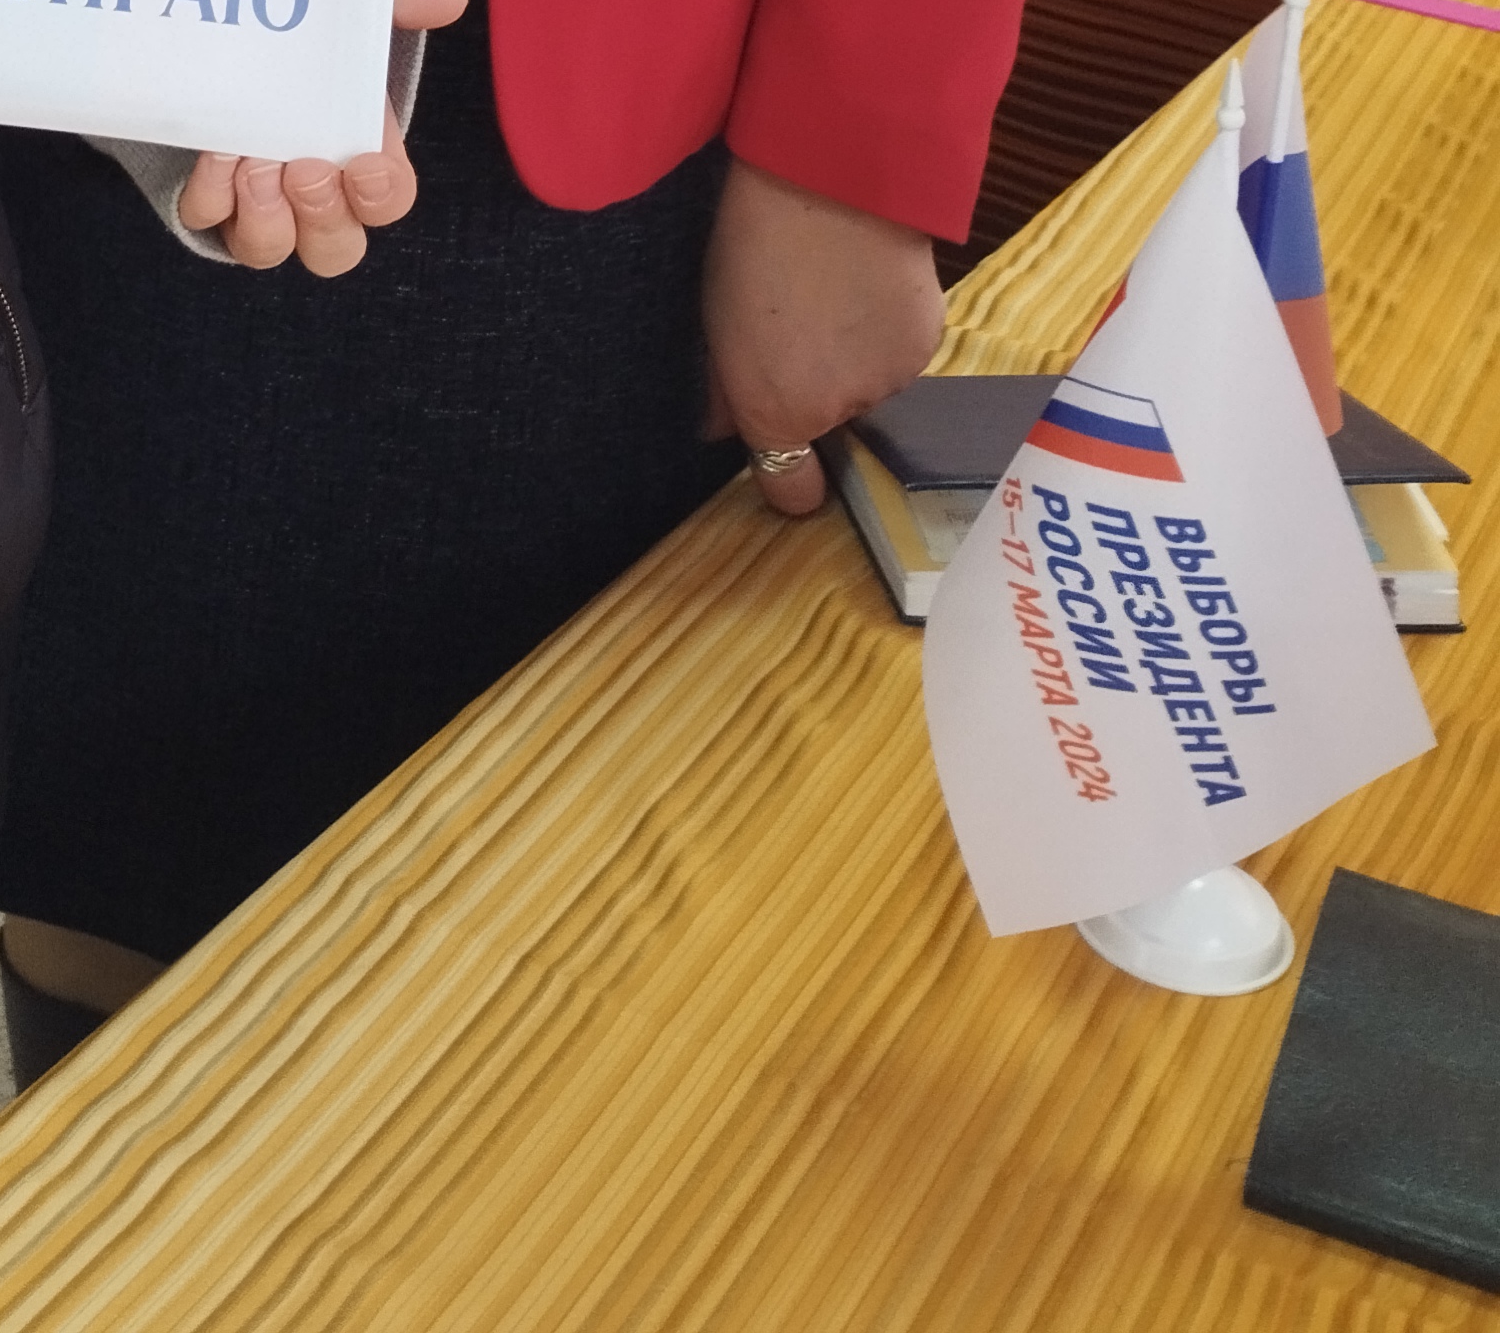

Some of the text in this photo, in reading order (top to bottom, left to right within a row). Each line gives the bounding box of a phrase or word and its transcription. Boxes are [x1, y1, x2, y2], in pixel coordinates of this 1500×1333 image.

[1007, 580, 1079, 706] МАРТА
[1048, 715, 1118, 802] 2024
[1032, 483, 1138, 693] РОССИИ
[1085, 501, 1247, 807] ПРЕЗИДЕНТА
[1153, 515, 1277, 716] ВЫБОРЫ
